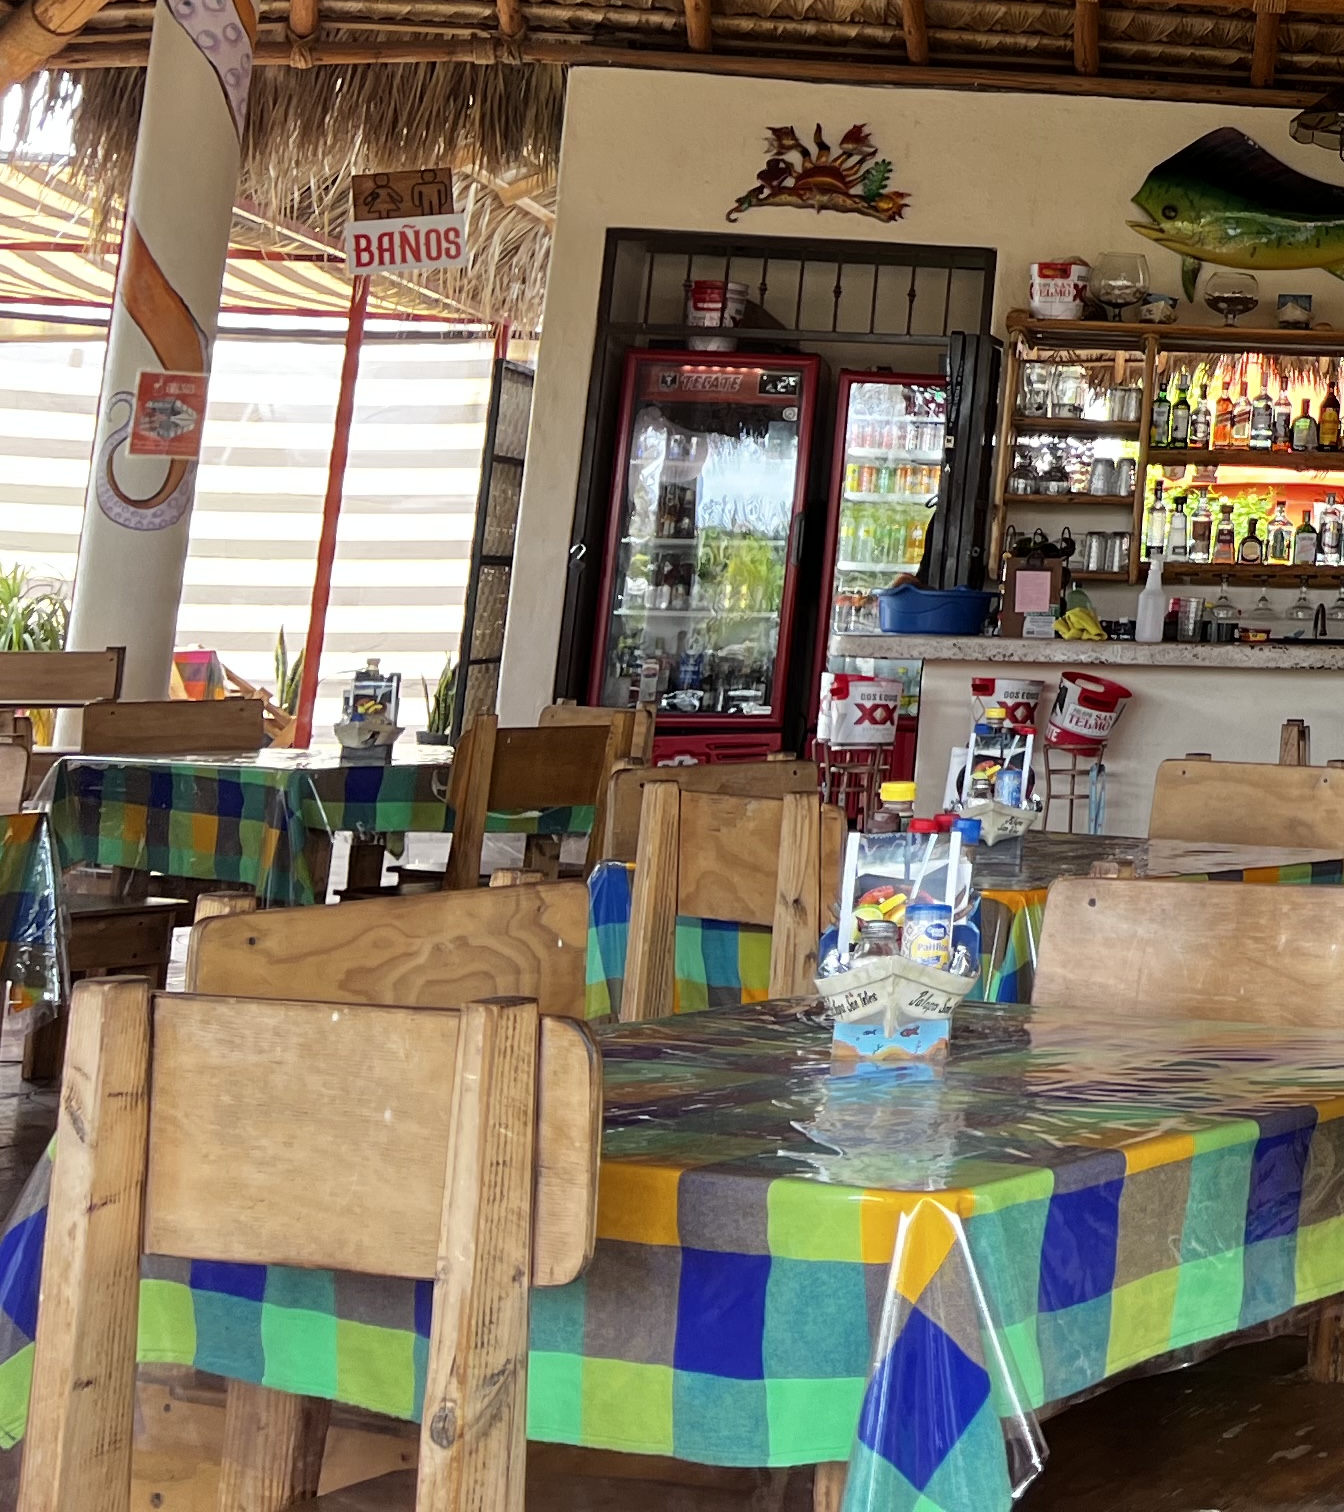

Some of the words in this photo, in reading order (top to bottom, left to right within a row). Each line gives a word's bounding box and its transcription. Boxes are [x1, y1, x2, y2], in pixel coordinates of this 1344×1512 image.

[353, 224, 461, 268] BAÑOS
[675, 373, 744, 391] TECATE
[853, 702, 898, 726] XX
[996, 701, 1039, 725] XX
